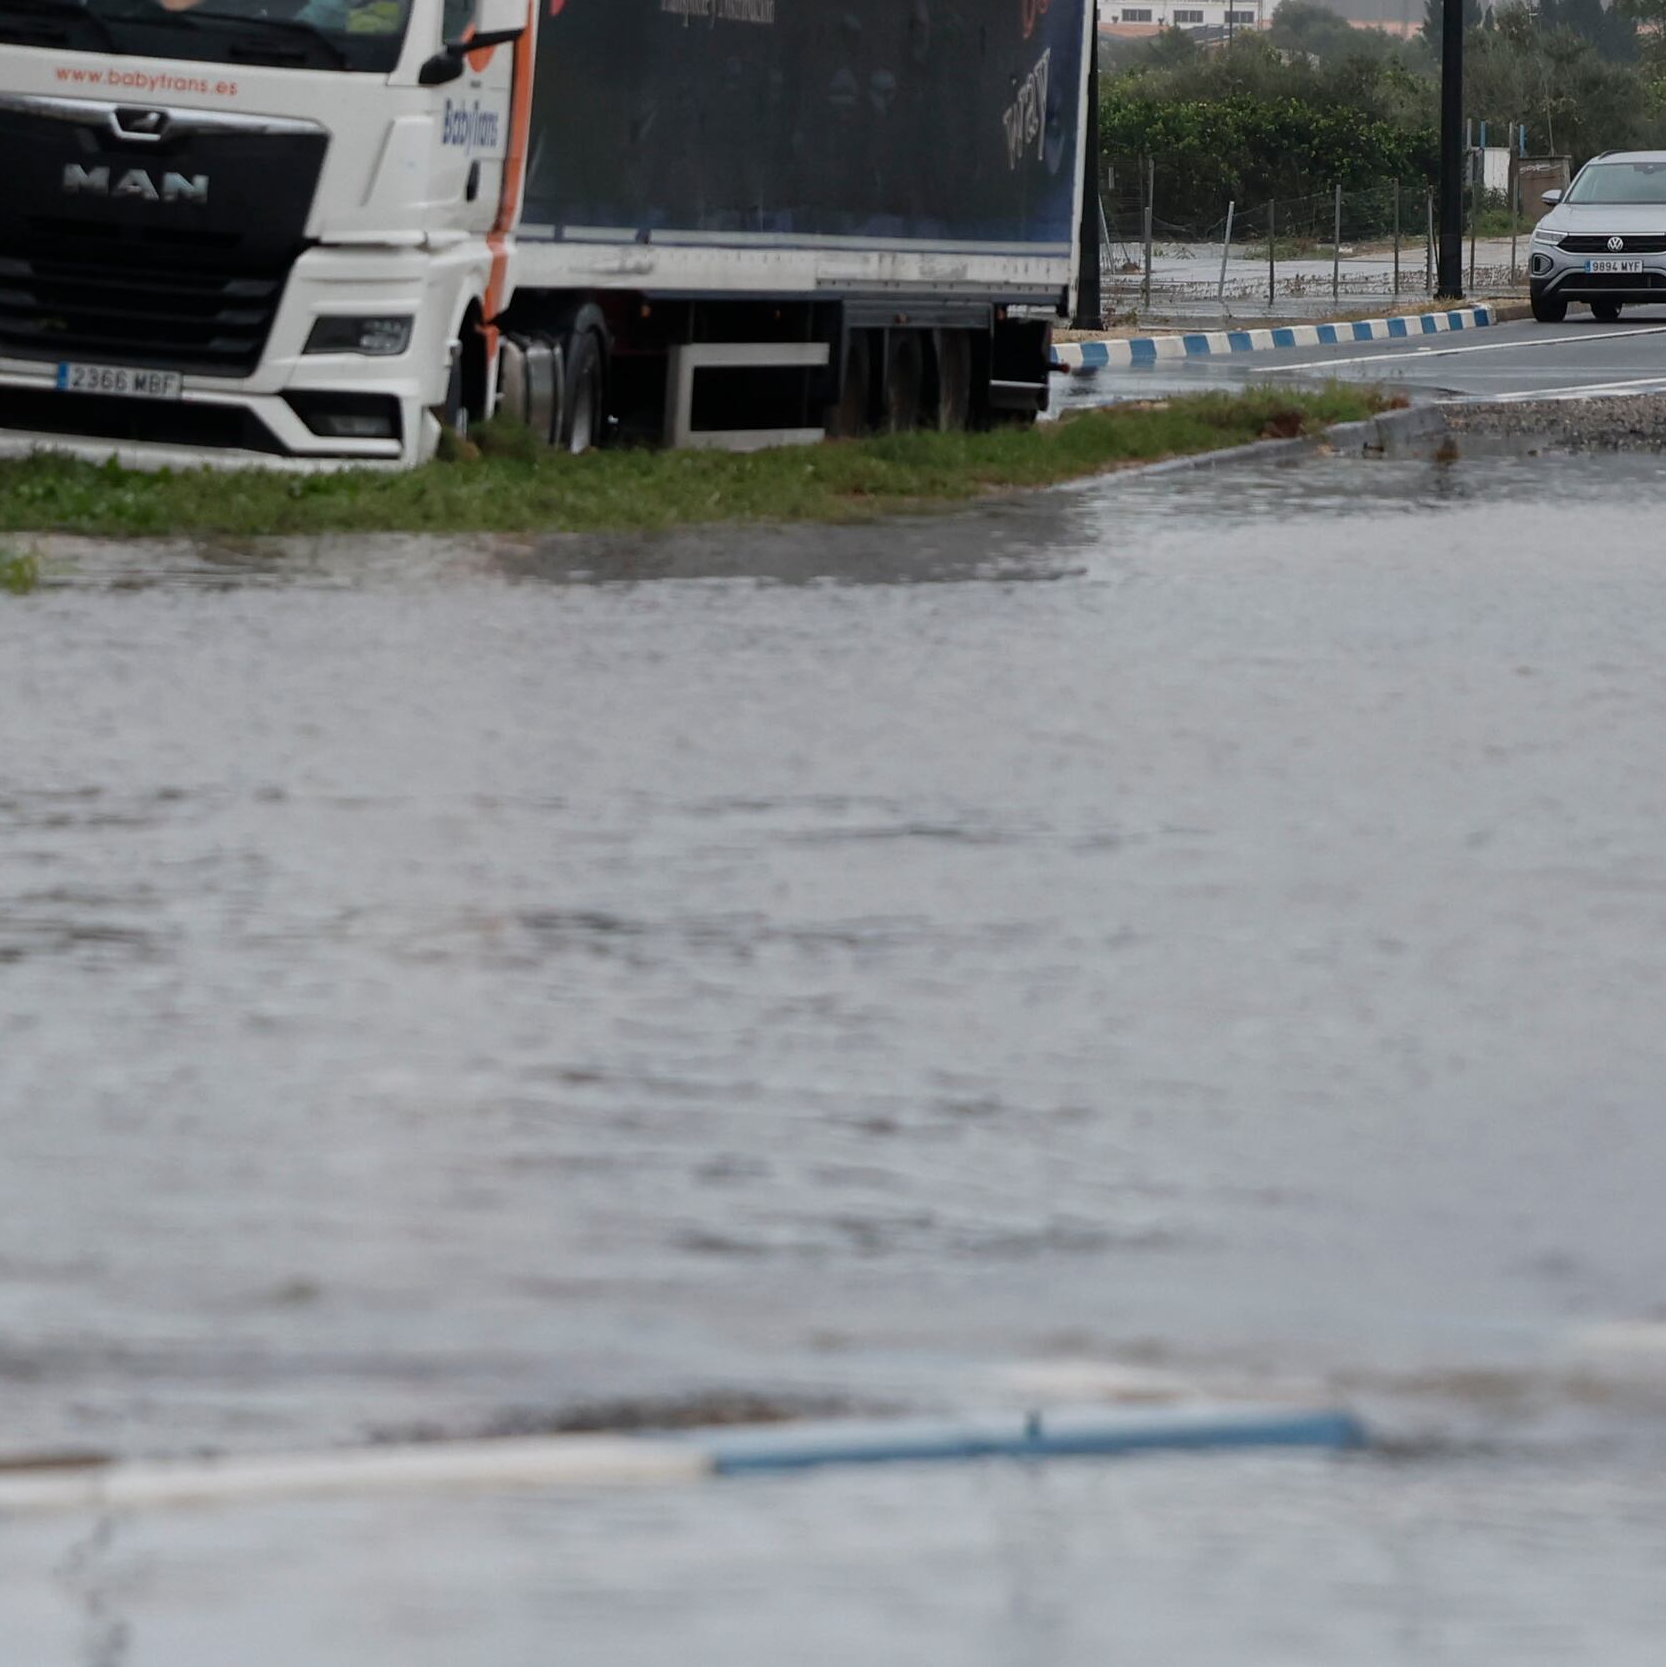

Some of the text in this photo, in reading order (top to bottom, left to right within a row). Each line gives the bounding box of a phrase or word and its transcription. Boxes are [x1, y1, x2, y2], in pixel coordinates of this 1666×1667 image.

[55, 67, 238, 96] www.babytrans.es
[443, 98, 498, 155] BabyTrans
[1003, 47, 1051, 170] way
[63, 163, 209, 203] MAN
[1592, 261, 1641, 272] 9894 MYF
